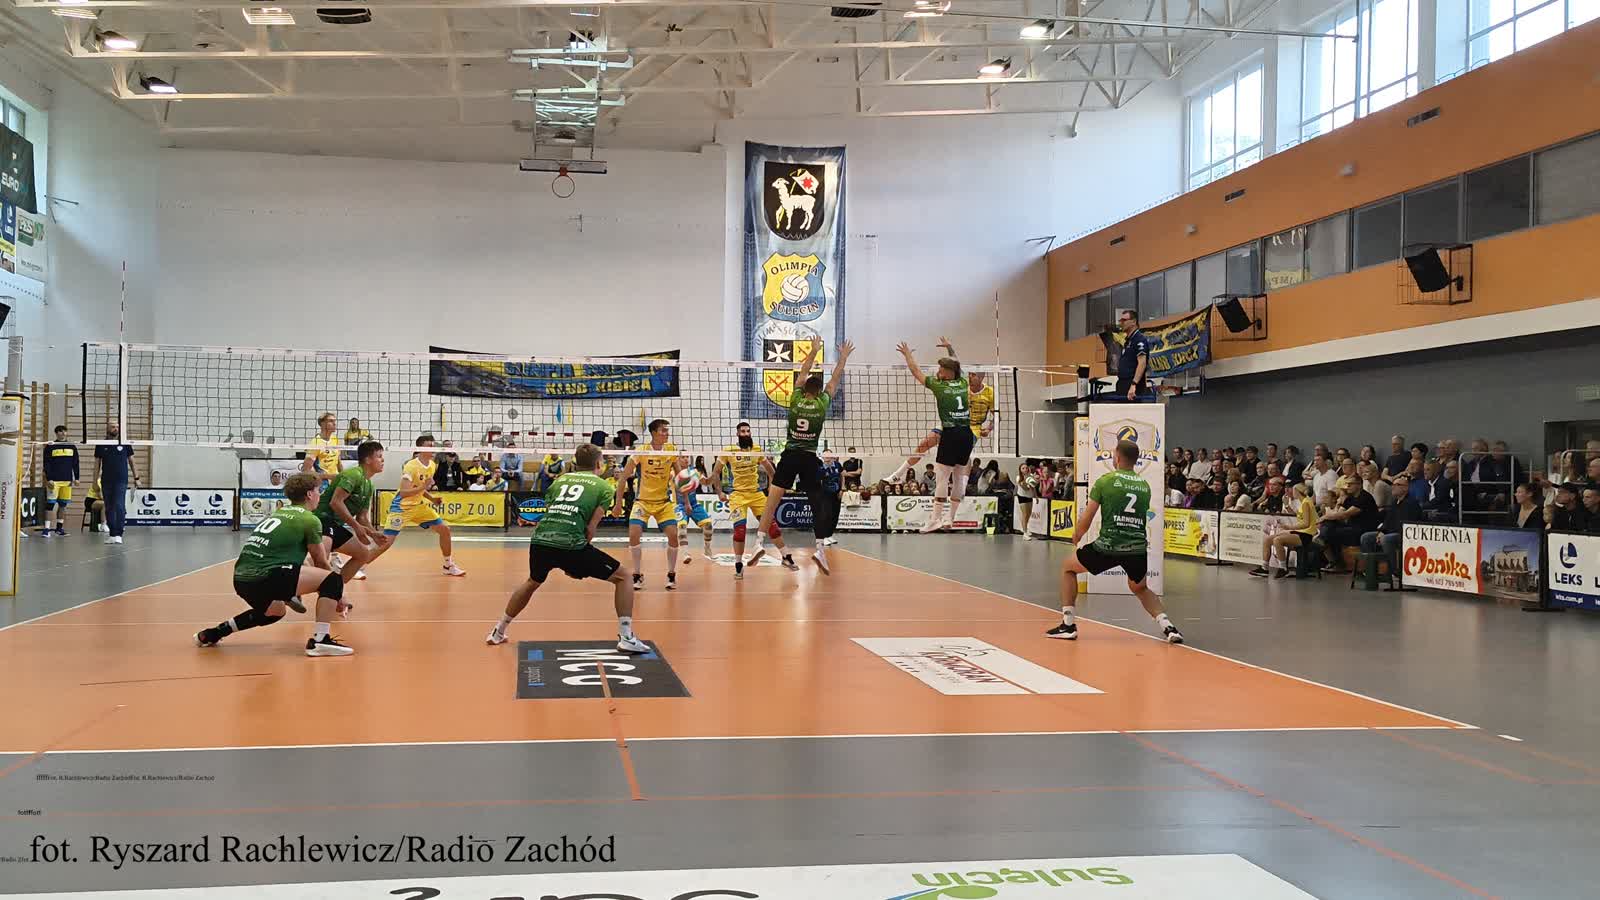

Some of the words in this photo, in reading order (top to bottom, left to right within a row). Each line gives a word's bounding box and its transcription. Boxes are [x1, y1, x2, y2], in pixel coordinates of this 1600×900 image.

[770, 261, 818, 275] OLIMPIA
[955, 396, 965, 410] 1
[796, 418, 810, 431] 9
[555, 485, 585, 502] 19
[468, 503, 475, 515] Z
[1123, 492, 1138, 513] 2
[1113, 515, 1144, 526] TARNOVIA
[1405, 526, 1472, 544] CUKIERNIA
[1404, 545, 1472, 580] Monika
[1555, 572, 1583, 586] LEKS
[911, 867, 1135, 887] Sulęcin
